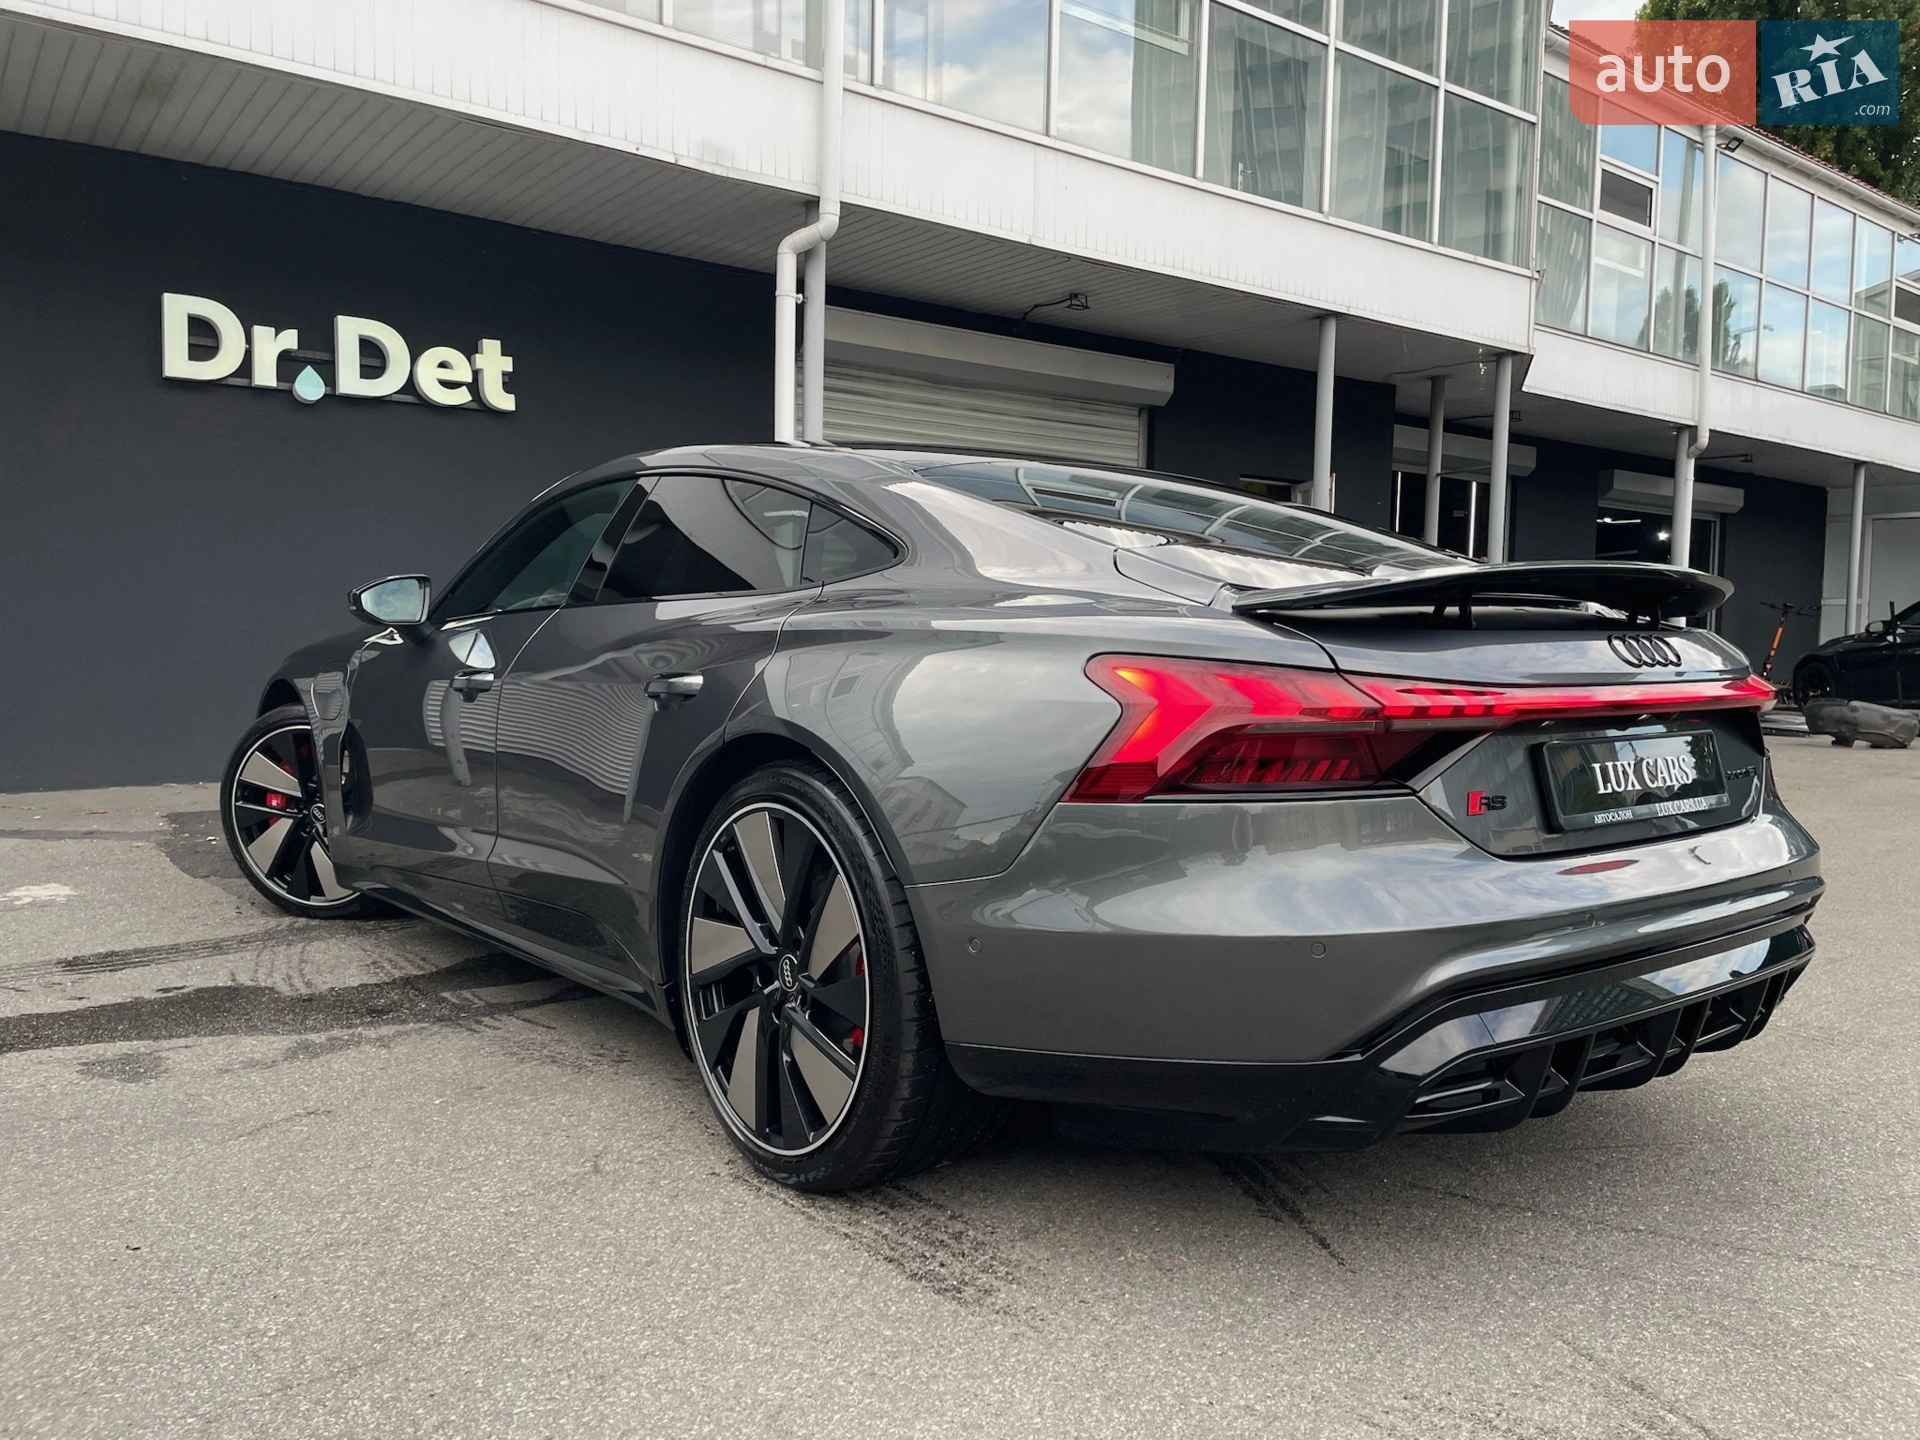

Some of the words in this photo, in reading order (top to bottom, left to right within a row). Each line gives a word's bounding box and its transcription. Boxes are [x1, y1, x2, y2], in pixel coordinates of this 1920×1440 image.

[1592, 760, 1642, 794] LUX
[1642, 755, 1693, 789] CARS
[1467, 791, 1508, 816] RS
[1594, 809, 1633, 824] АВТОСАЛОН
